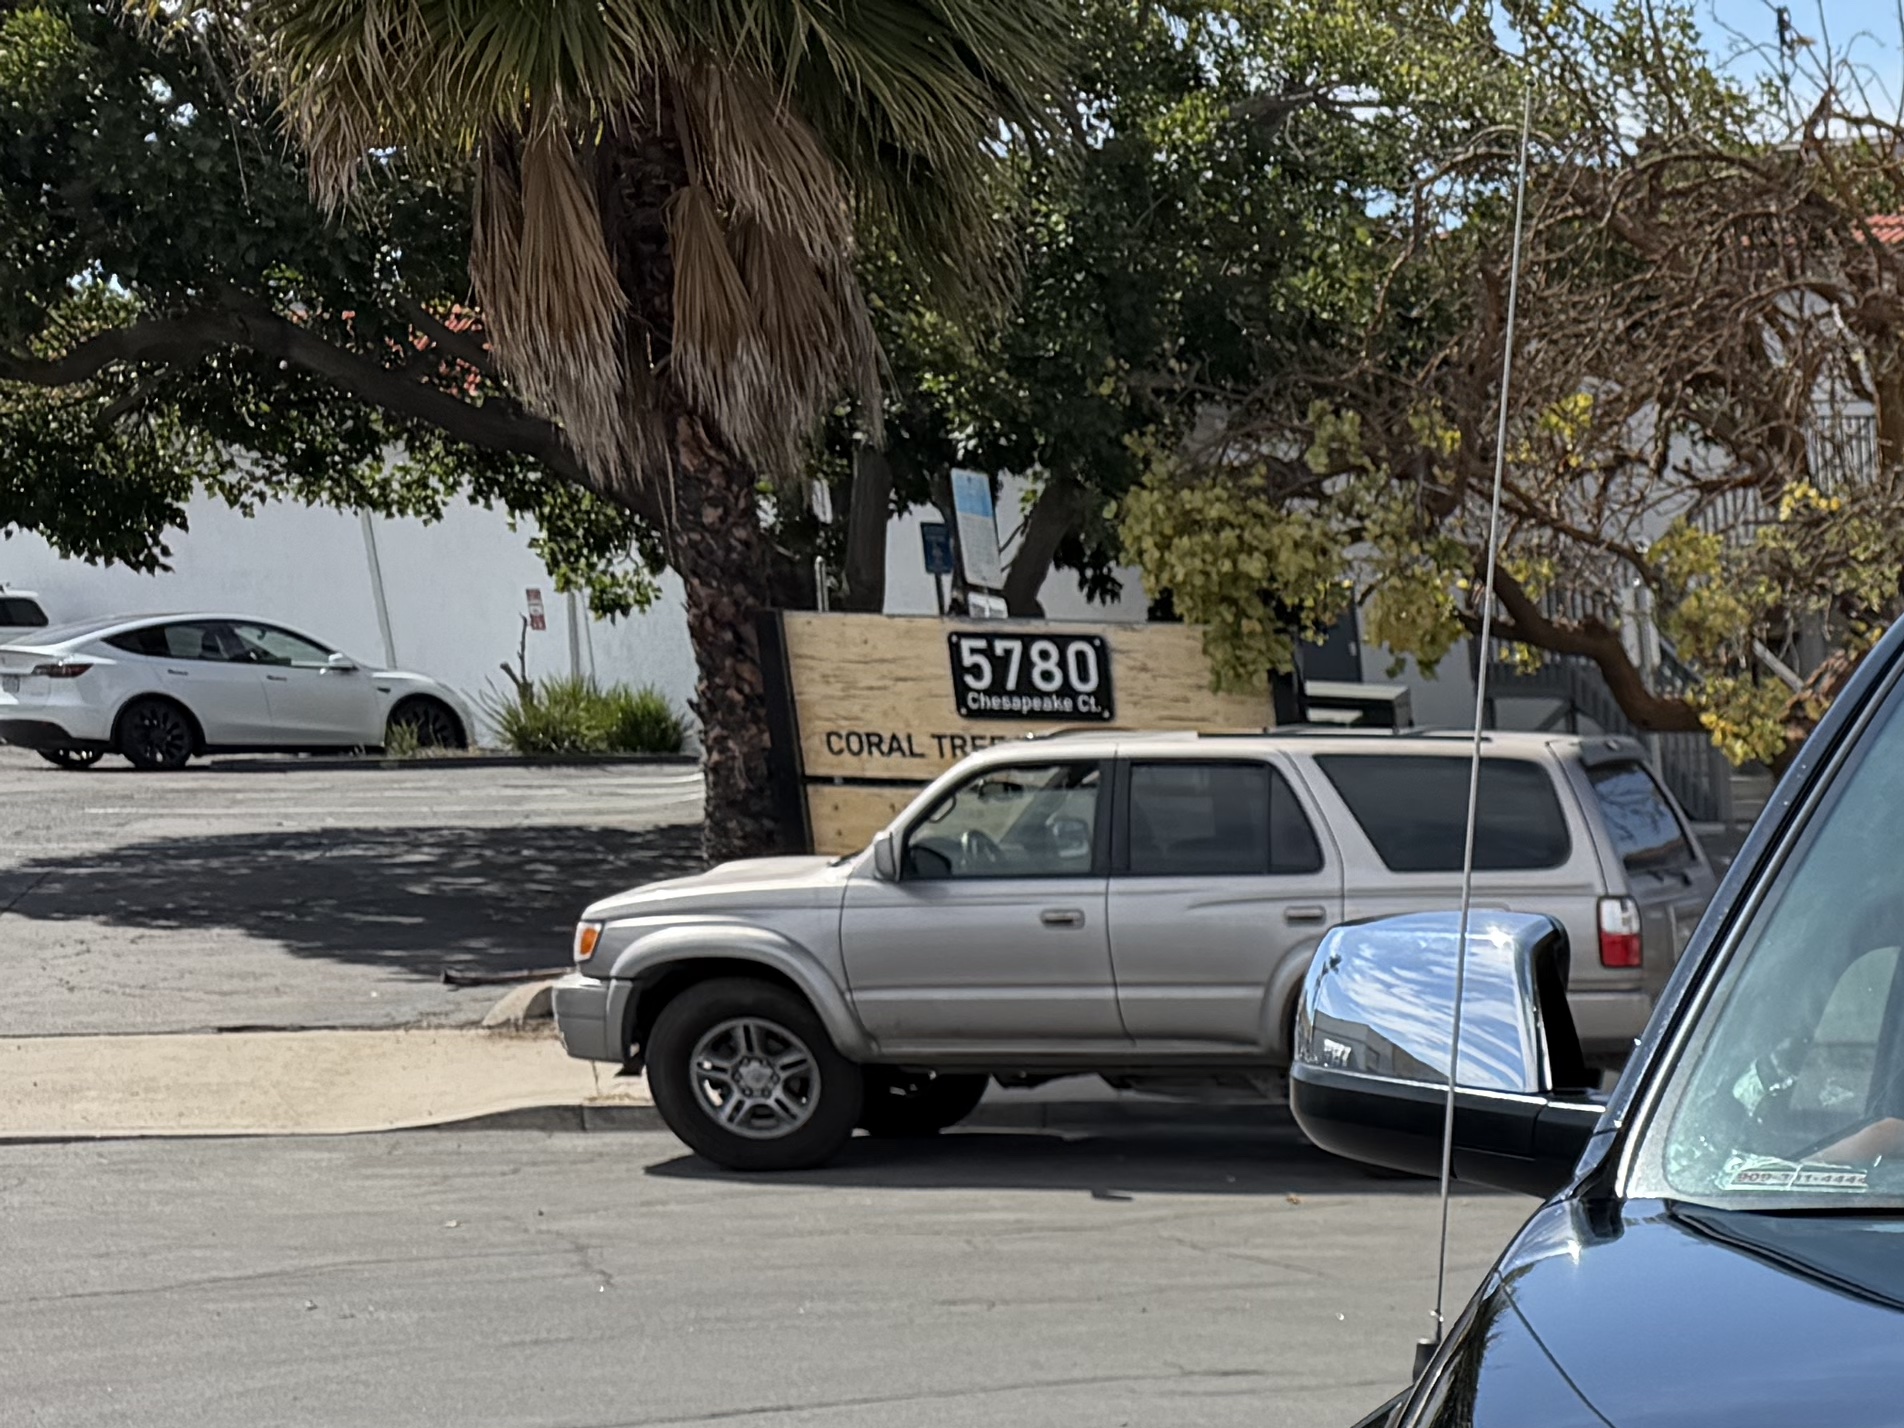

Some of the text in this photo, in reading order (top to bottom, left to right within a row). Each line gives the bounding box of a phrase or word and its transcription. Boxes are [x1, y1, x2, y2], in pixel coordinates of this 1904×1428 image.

[960, 638, 1099, 692] 5780
[967, 693, 1102, 714] Chesapeake Ct.
[826, 732, 925, 758] CORAL
